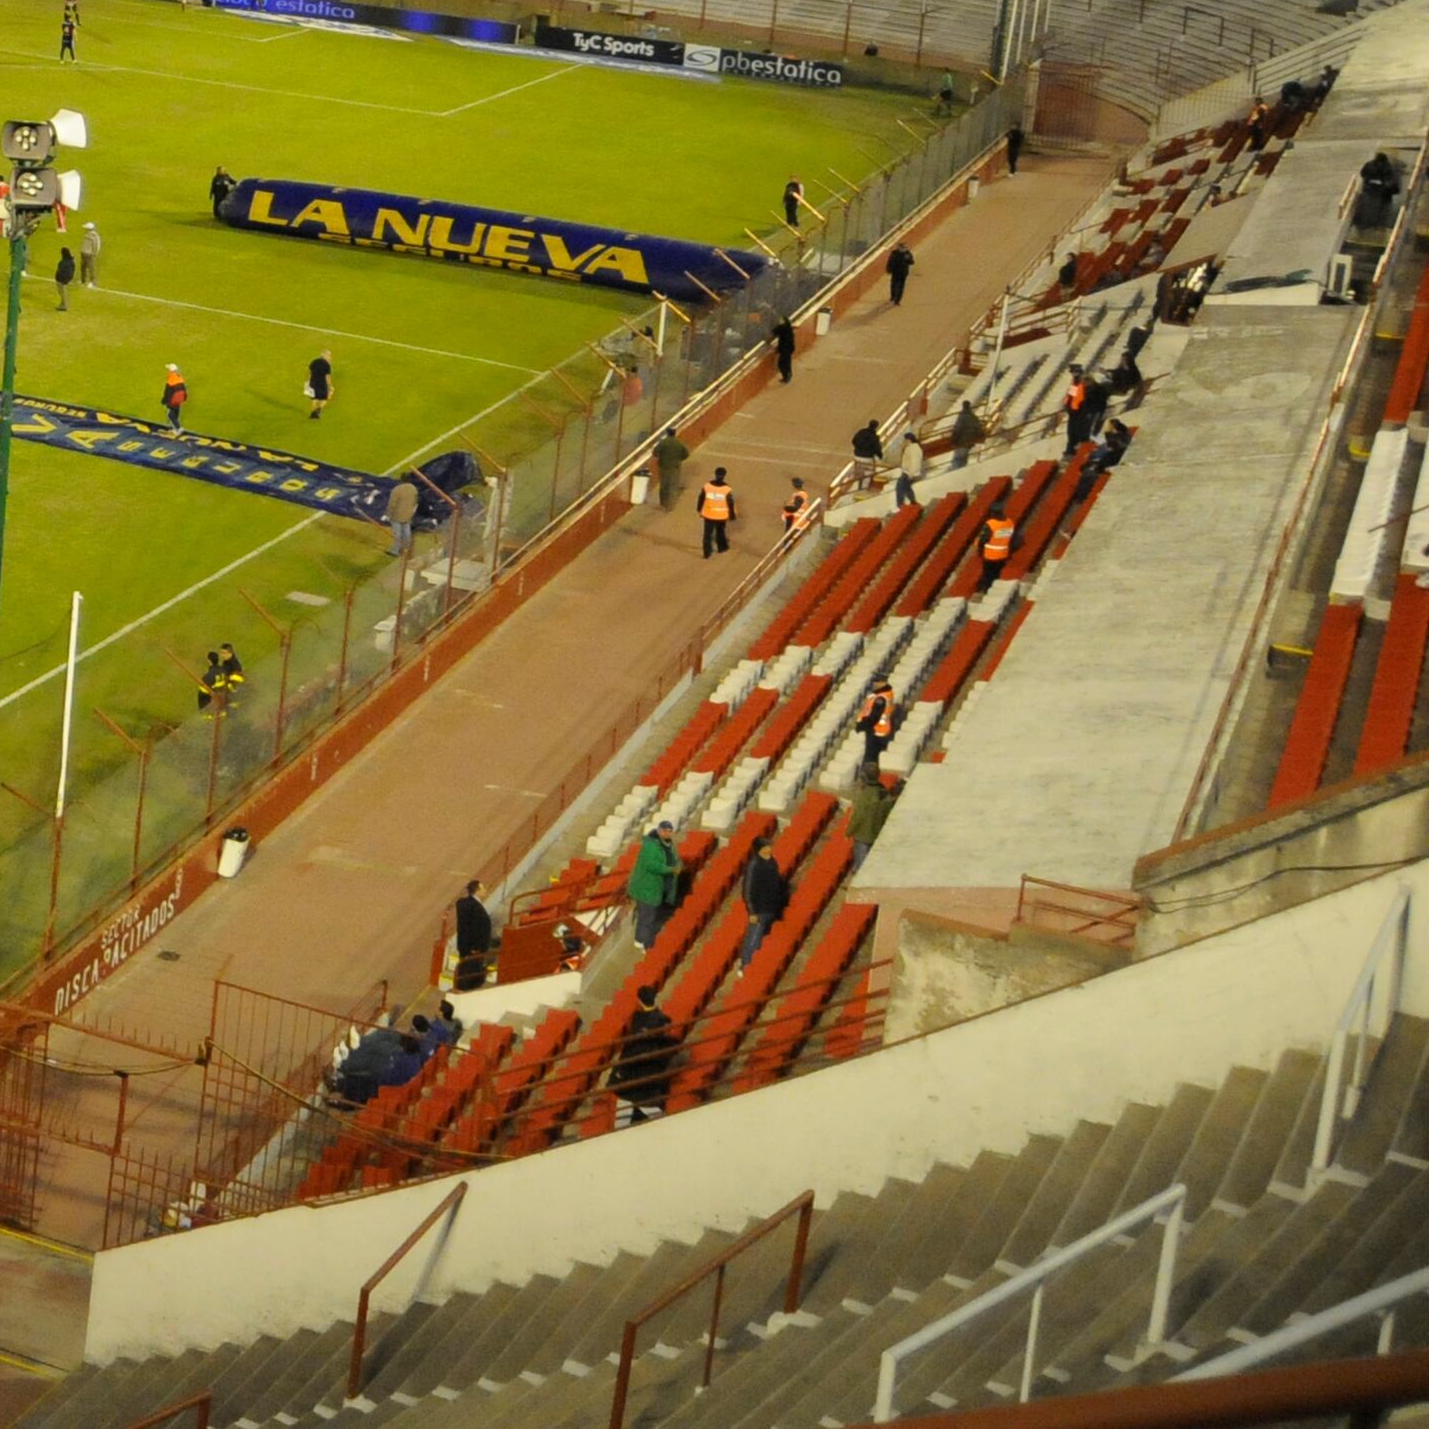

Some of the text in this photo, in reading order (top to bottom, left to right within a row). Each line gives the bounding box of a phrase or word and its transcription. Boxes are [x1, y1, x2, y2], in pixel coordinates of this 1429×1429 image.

[572, 32, 656, 57] TyC Sports
[720, 47, 842, 85] pbestatica
[247, 190, 650, 285] LA NUEVA
